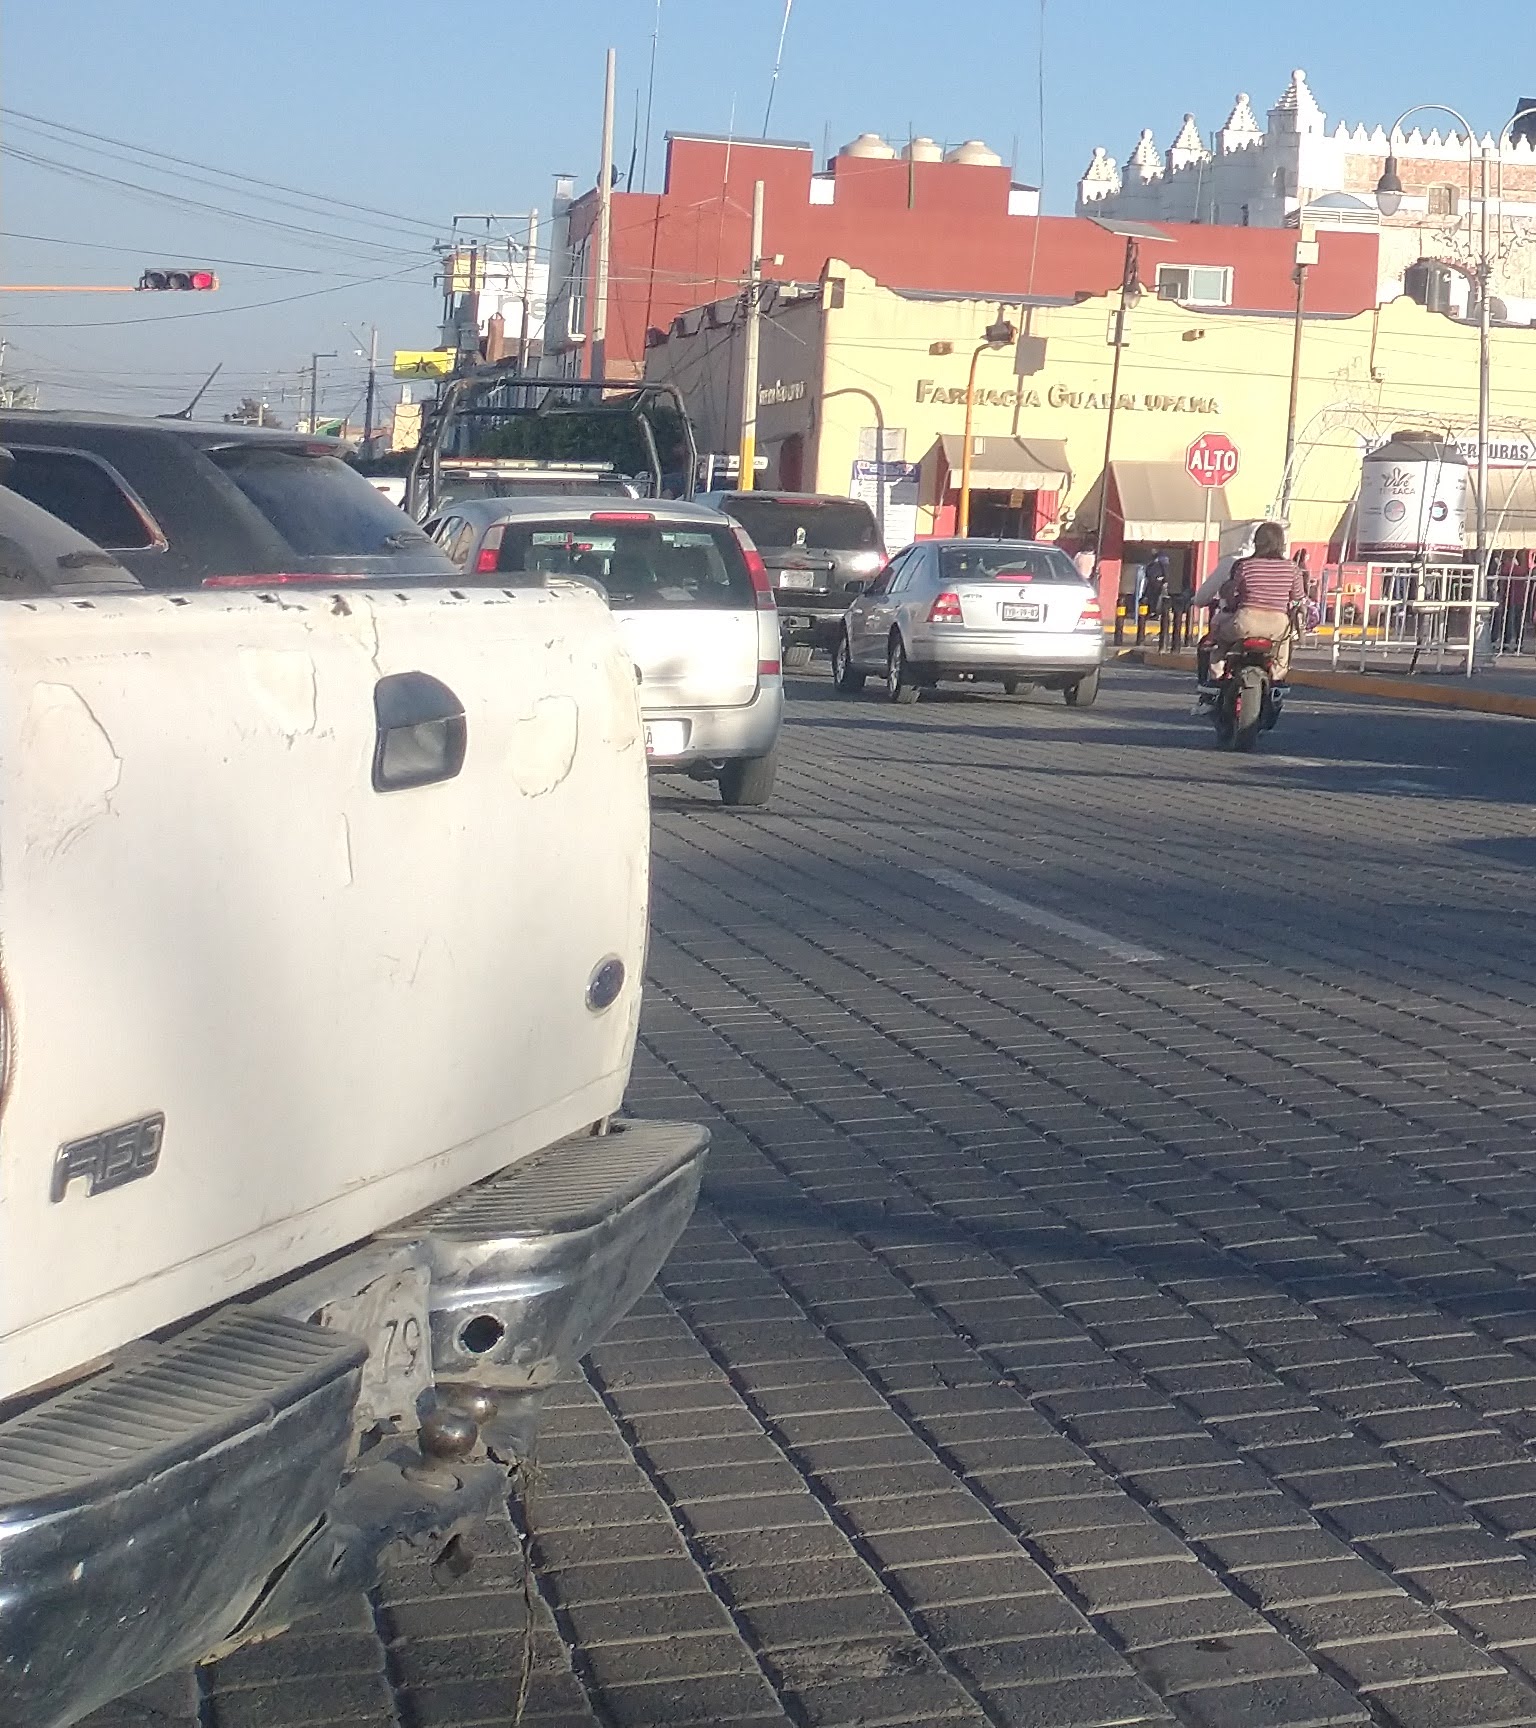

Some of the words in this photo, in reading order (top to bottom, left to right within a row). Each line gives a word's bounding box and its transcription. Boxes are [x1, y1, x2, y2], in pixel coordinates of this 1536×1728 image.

[916, 379, 1042, 408] FARMACIA
[1189, 449, 1236, 471] ALTO
[1452, 442, 1529, 460] ERURAS
